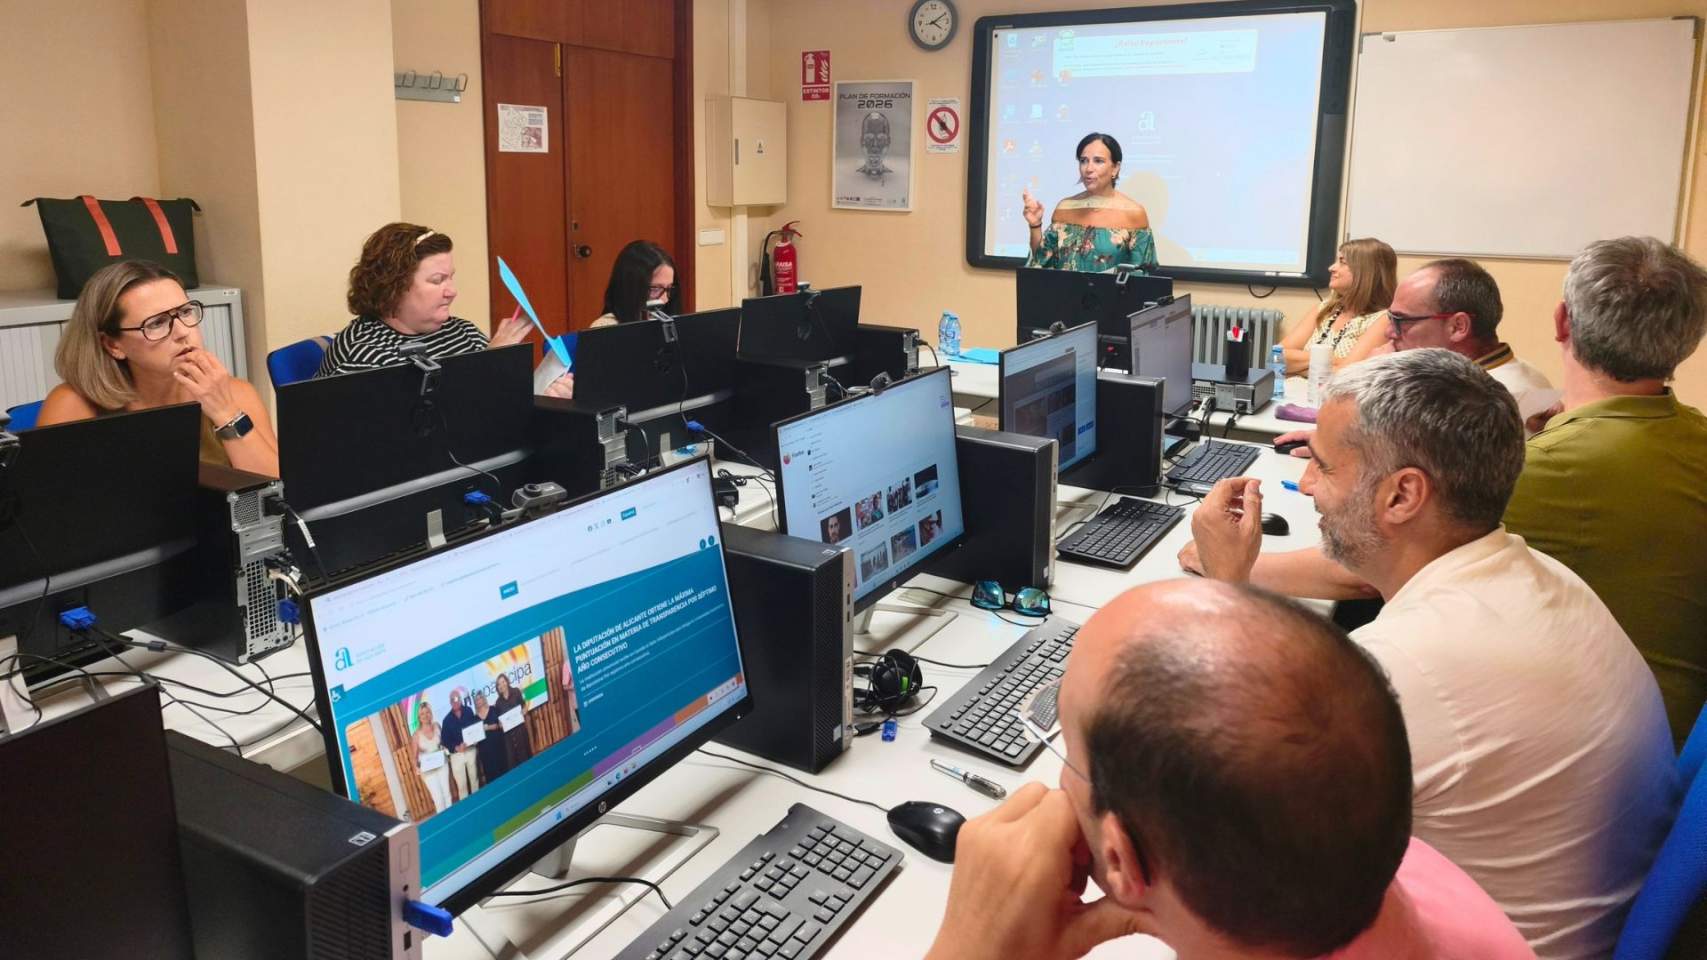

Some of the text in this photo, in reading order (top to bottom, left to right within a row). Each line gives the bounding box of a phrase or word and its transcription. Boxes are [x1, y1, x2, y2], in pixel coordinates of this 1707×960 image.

[857, 100, 893, 109] 2026
[573, 644, 581, 653] LA
[581, 627, 615, 649] DIPUTACIÓN
[615, 624, 622, 632] DE
[623, 610, 647, 628] ALICANTE
[647, 601, 668, 615] OBTIENE
[674, 587, 694, 601] MÁXIMA
[575, 639, 611, 663] PUNTUACIÓN
[611, 636, 619, 646] EN
[619, 624, 642, 640] MATERIA
[642, 620, 650, 628] DE
[649, 601, 688, 624] TRANSPARENCIA
[688, 595, 697, 604] POR
[697, 585, 717, 599] SÉPTIMO
[577, 662, 590, 674] AÑO
[590, 641, 628, 665] CONSECUTIVO
